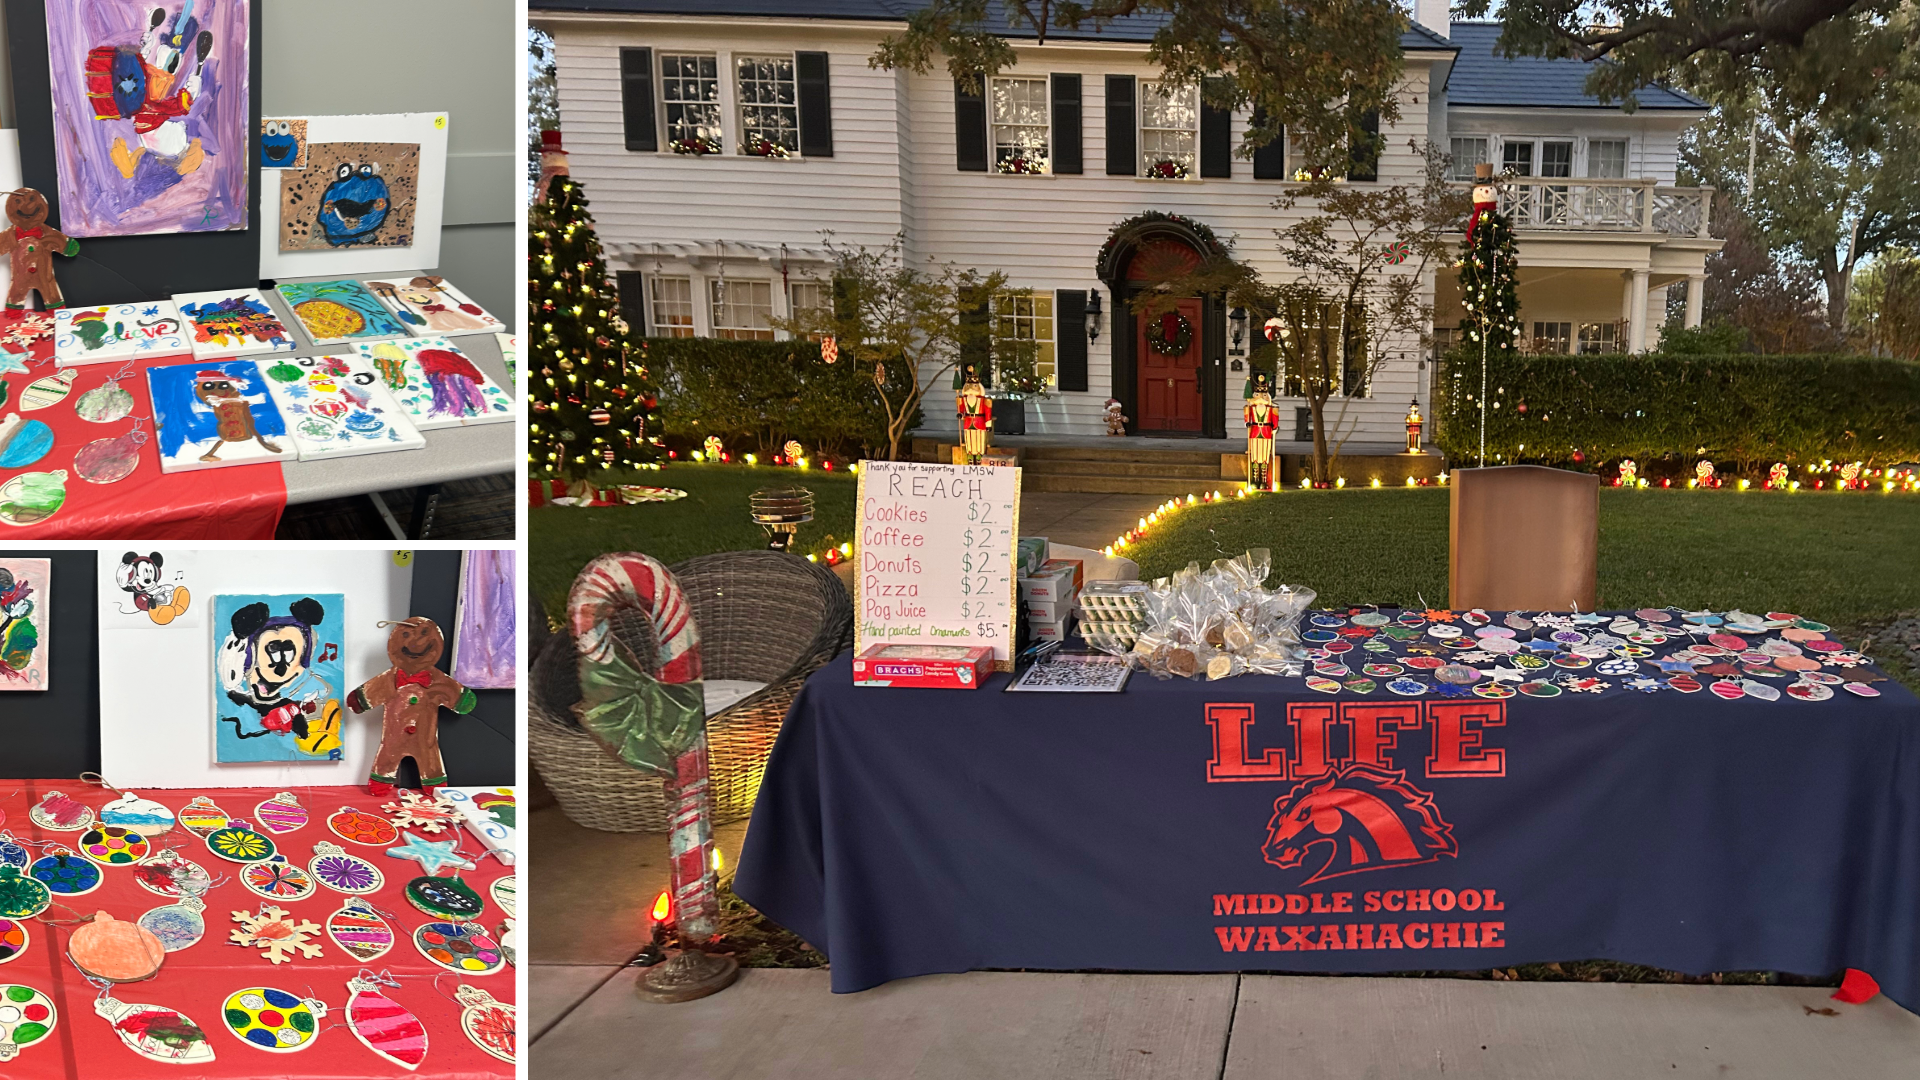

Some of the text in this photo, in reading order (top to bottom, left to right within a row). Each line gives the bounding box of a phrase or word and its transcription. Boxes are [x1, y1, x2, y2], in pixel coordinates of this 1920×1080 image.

[865, 461, 995, 476] Thank you for supporting LMSW
[888, 474, 983, 500] REACH
[864, 497, 928, 523] Cookies
[864, 526, 924, 547] Coffee
[397, 550, 411, 560] $5
[864, 551, 922, 574] Donuts
[866, 575, 918, 597] Pizza
[866, 598, 891, 620] Pog
[896, 599, 926, 618] Juice
[861, 621, 885, 637] Hand
[888, 622, 922, 640] painted
[1204, 700, 1507, 783] LIFE
[1212, 888, 1505, 916] MIDDLE SCHOOL
[1214, 921, 1505, 952] WAXAHACHIE
